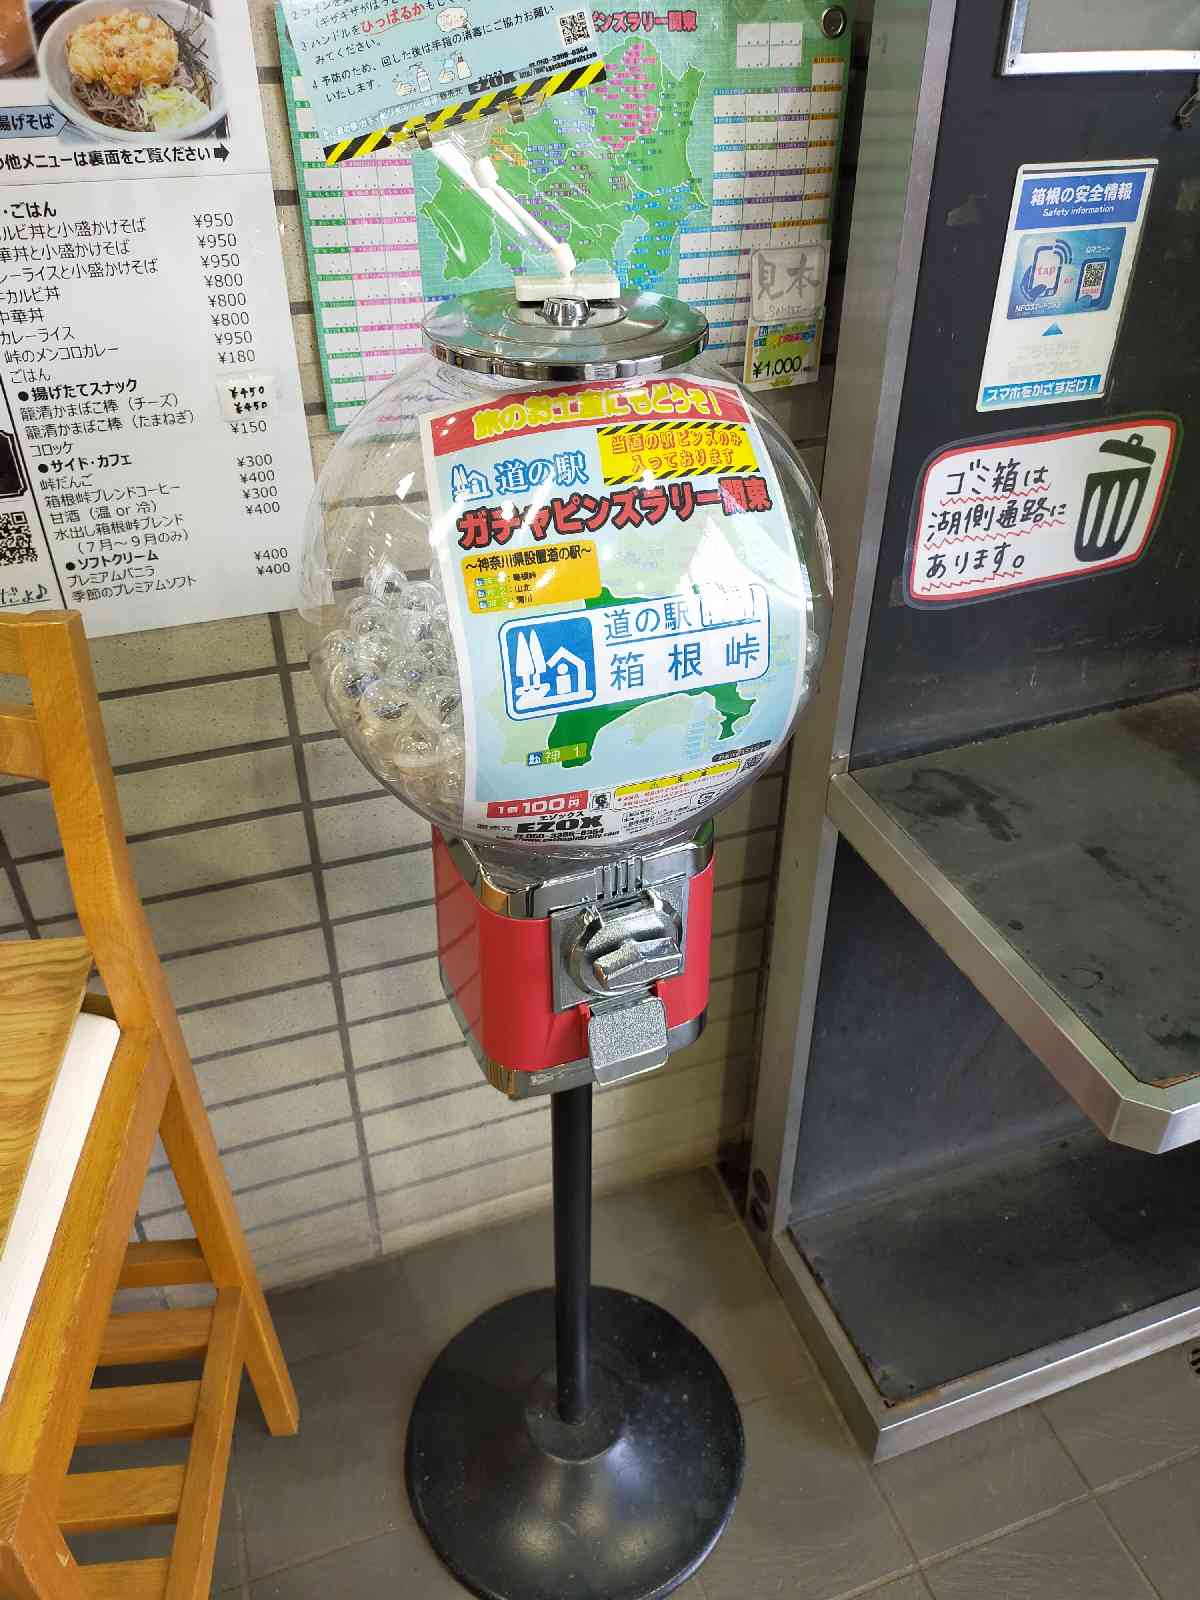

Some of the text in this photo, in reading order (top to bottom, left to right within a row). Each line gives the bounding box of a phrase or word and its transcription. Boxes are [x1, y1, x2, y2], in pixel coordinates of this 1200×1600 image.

[1030, 182, 1133, 206] 箱根の安全情報
[1042, 205, 1115, 217] Safety information
[0, 217, 147, 241] ルビ丼と小盛かけそば
[193, 212, 234, 229] ¥950
[197, 233, 237, 249] ¥950
[201, 253, 241, 269] ¥950
[204, 273, 243, 289] ¥800
[757, 252, 821, 301] 見本
[208, 292, 247, 308] ¥800
[211, 312, 250, 327] ¥800
[215, 330, 253, 345] ¥950
[4, 343, 120, 365] 峠のメンコロカレー
[218, 349, 256, 364] ¥180
[752, 356, 802, 378] ¥1,000
[9, 368, 51, 385] ごはん
[230, 420, 267, 434] ¥150
[236, 453, 273, 468] ¥300
[240, 470, 275, 484] ¥400
[495, 450, 590, 494] 道の駅
[945, 458, 1049, 496] ゴミ箱は
[45, 483, 181, 509] 箱根峠ブレンドコーヒー
[242, 486, 279, 500] ¥300
[245, 502, 281, 515] ¥400
[927, 498, 1067, 543] 湖側通路に
[254, 548, 289, 562] ¥400
[926, 542, 1025, 579] あります。
[67, 566, 156, 588] プレミアムバニラ
[256, 562, 291, 577] ¥400
[71, 576, 197, 602] 季節のプレミアムソフト
[603, 600, 690, 641] 道の駅
[517, 815, 603, 833] EZOX
